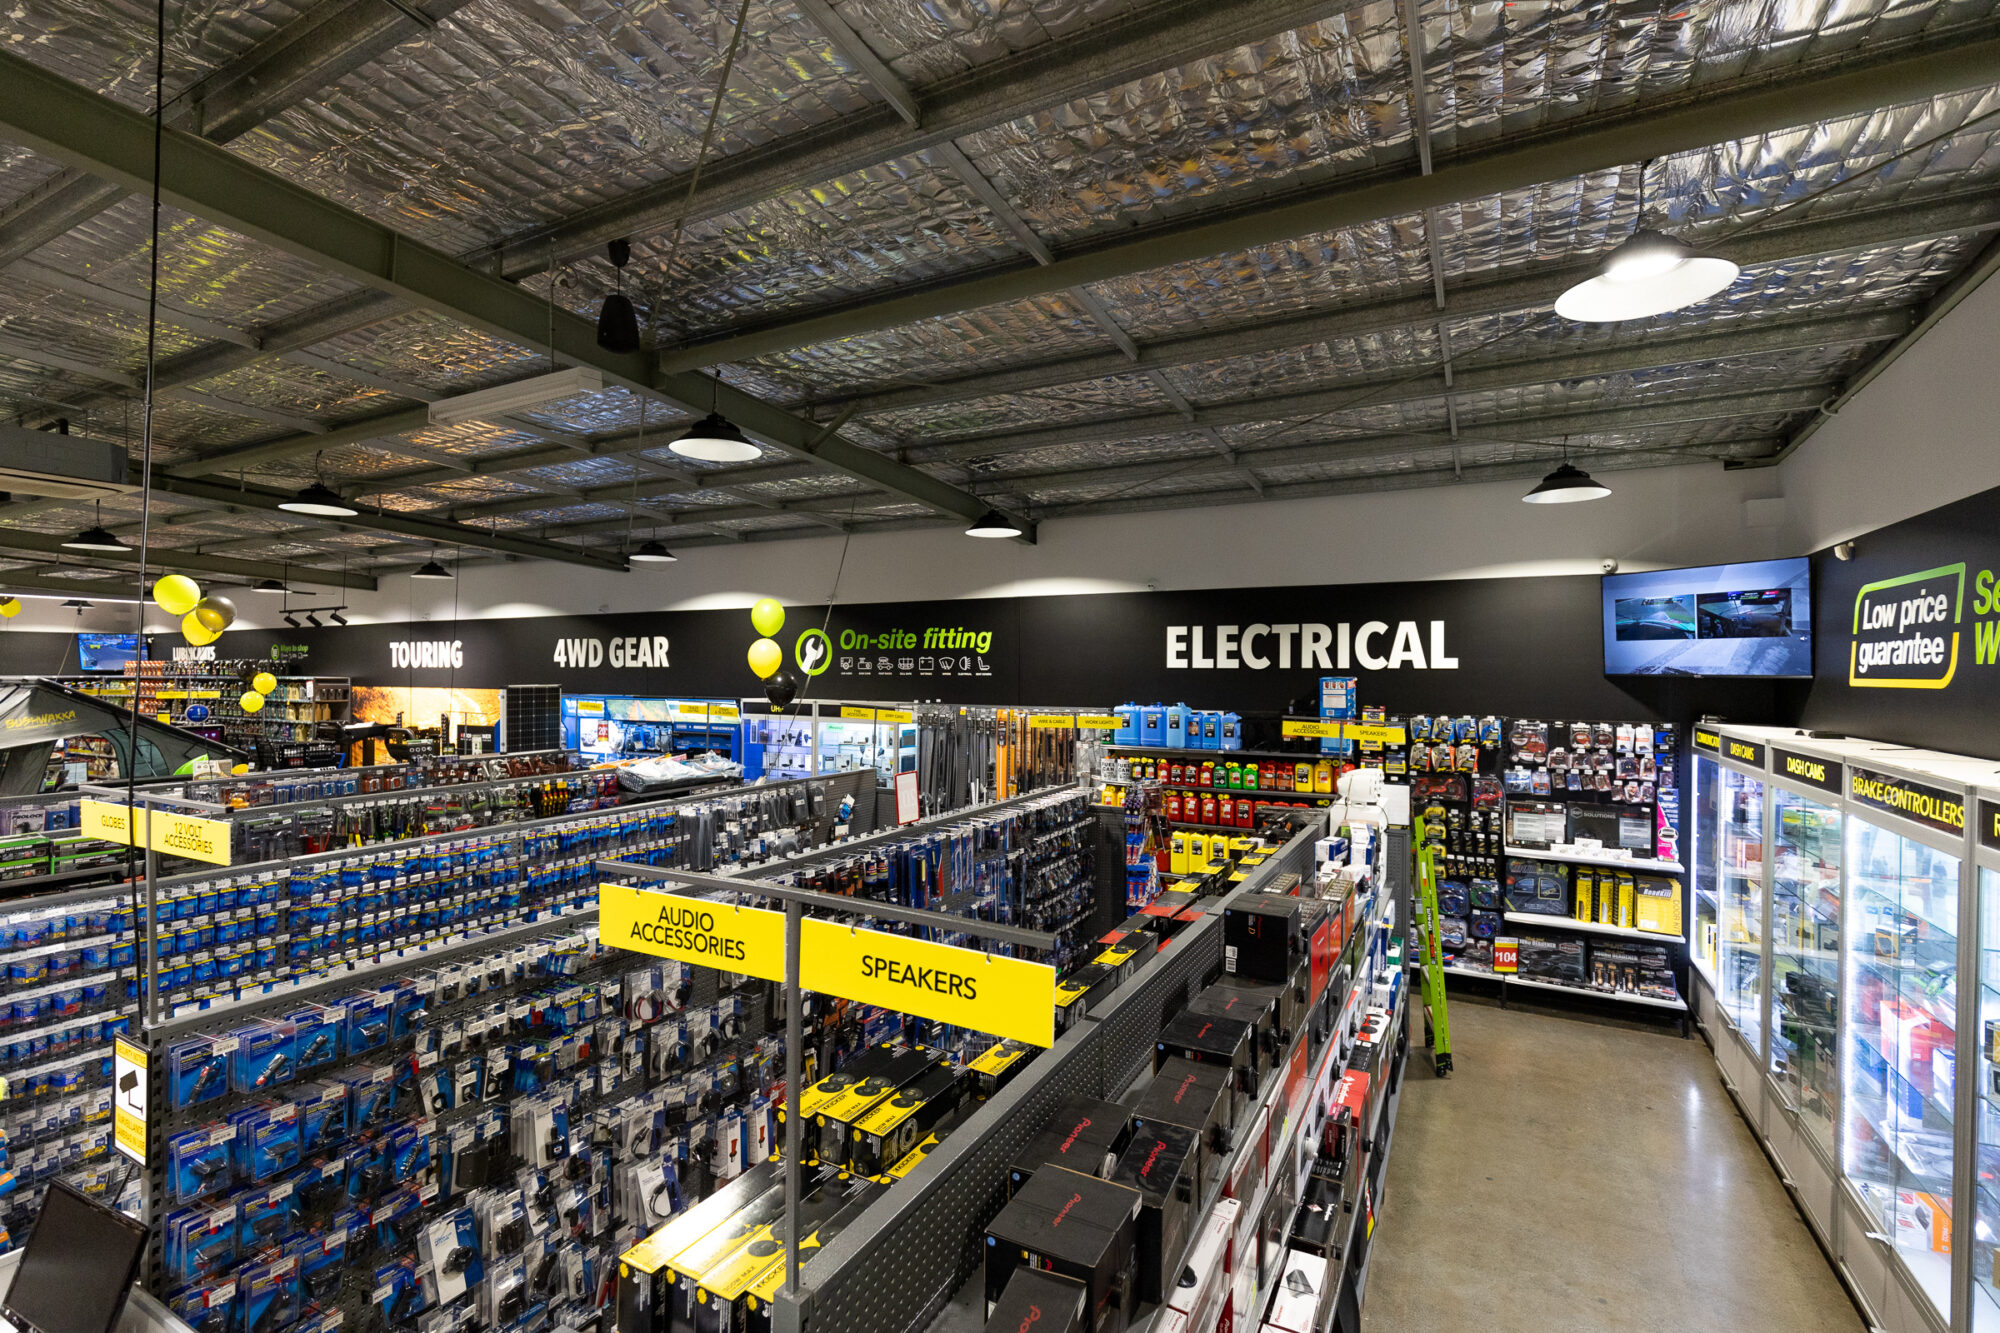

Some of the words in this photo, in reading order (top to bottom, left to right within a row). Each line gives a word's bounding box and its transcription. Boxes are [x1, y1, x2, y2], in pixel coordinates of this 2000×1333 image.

[1862, 598, 1898, 631] Low
[1899, 588, 1948, 634] price
[553, 638, 604, 668] 4WD
[608, 636, 670, 668] GEAR
[839, 627, 917, 650] On-site
[923, 626, 993, 654] fitting
[1166, 620, 1459, 671] ELECTRICAL
[1858, 631, 1945, 673] guarantee
[389, 640, 463, 669] TOURING
[1292, 727, 1329, 736] ACCESSORIES
[1359, 730, 1388, 738] SPEAKERS
[1741, 745, 1755, 761] CAMS
[1786, 756, 1804, 777] DASH
[1804, 760, 1826, 783] CAMS
[12, 812, 44, 820] PROLOCK
[1852, 776, 1884, 802] BRAKE
[1884, 784, 1964, 829] CONTROLLERS
[101, 814, 126, 830] GLOBES
[174, 822, 183, 835] 12
[182, 824, 203, 838] VOLT
[164, 834, 213, 854] ACCESSORIES
[657, 905, 714, 933] AUDIO
[630, 921, 745, 961] ACCESSORIES
[1495, 951, 1517, 963] $104
[861, 954, 977, 1000] SPEAKERS
[824, 1093, 848, 1112] KICKER
[859, 1106, 883, 1126] KICKER
[1060, 1117, 1092, 1154] Pioneer
[895, 1152, 918, 1172] KICKER
[1140, 1140, 1167, 1178] Pioneer
[1052, 1193, 1082, 1228] Pioneer
